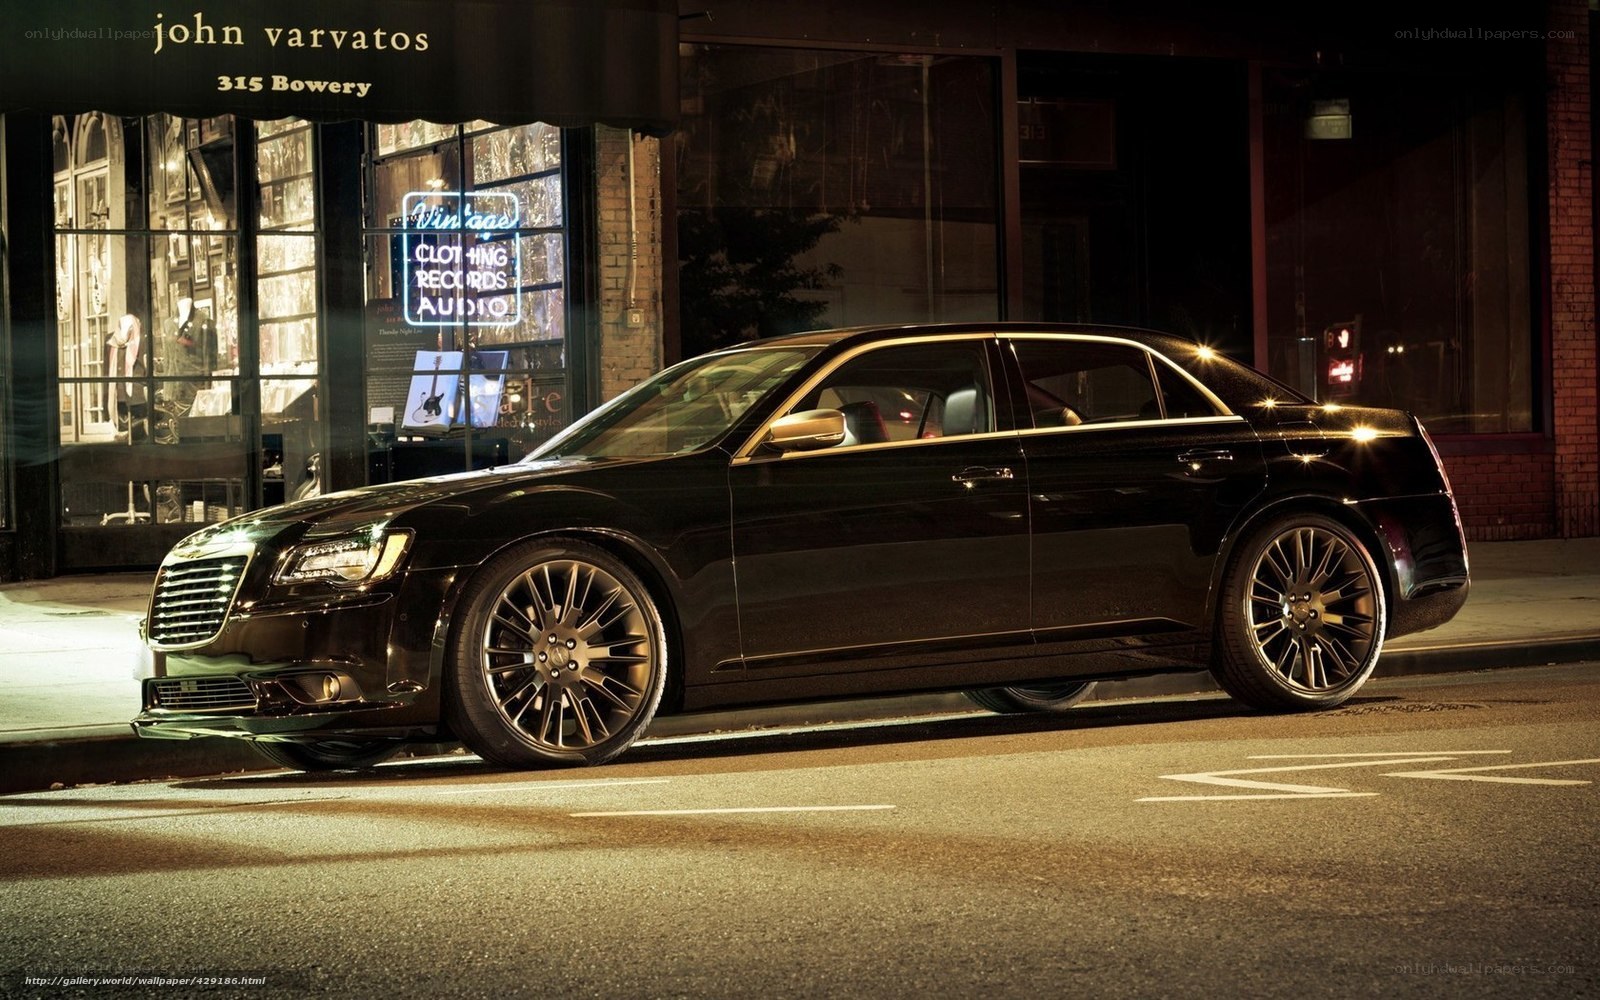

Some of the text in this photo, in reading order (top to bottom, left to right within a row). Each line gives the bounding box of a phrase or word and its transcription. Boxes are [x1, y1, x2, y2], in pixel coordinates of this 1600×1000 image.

[154, 12, 430, 54] john varvatos
[217, 75, 372, 97] 315 Bowery
[415, 244, 508, 267] CLOTHING
[415, 270, 508, 290] RECORDS
[416, 297, 509, 317] AUDIO
